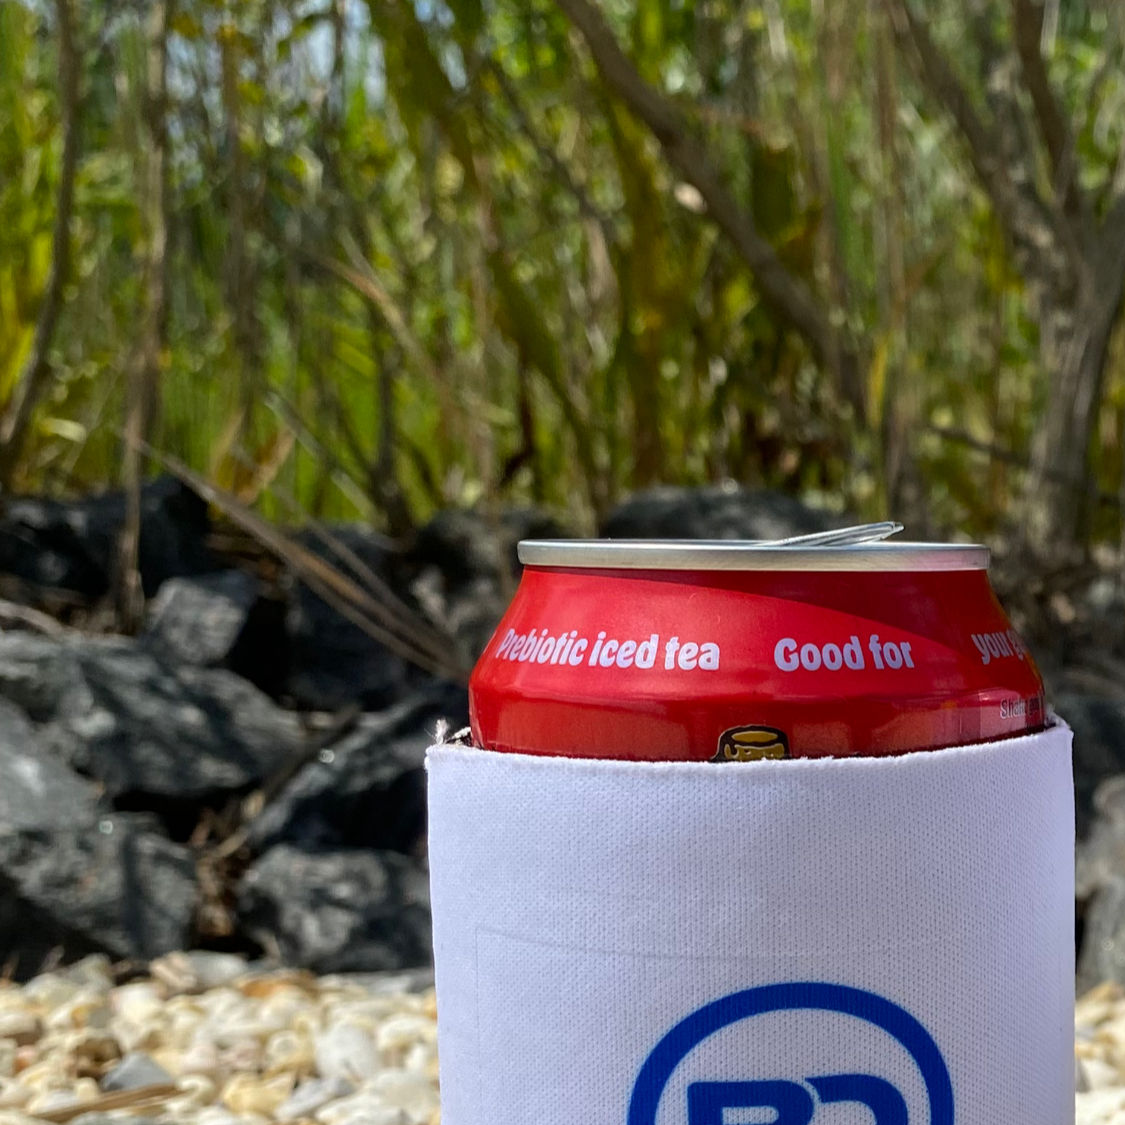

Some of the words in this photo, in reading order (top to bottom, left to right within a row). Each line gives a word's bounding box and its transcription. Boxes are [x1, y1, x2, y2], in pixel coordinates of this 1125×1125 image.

[495, 628, 589, 667] Prebiotic
[588, 631, 660, 669] iced
[664, 636, 721, 671] tea
[773, 637, 866, 672] Good
[868, 633, 915, 670] for
